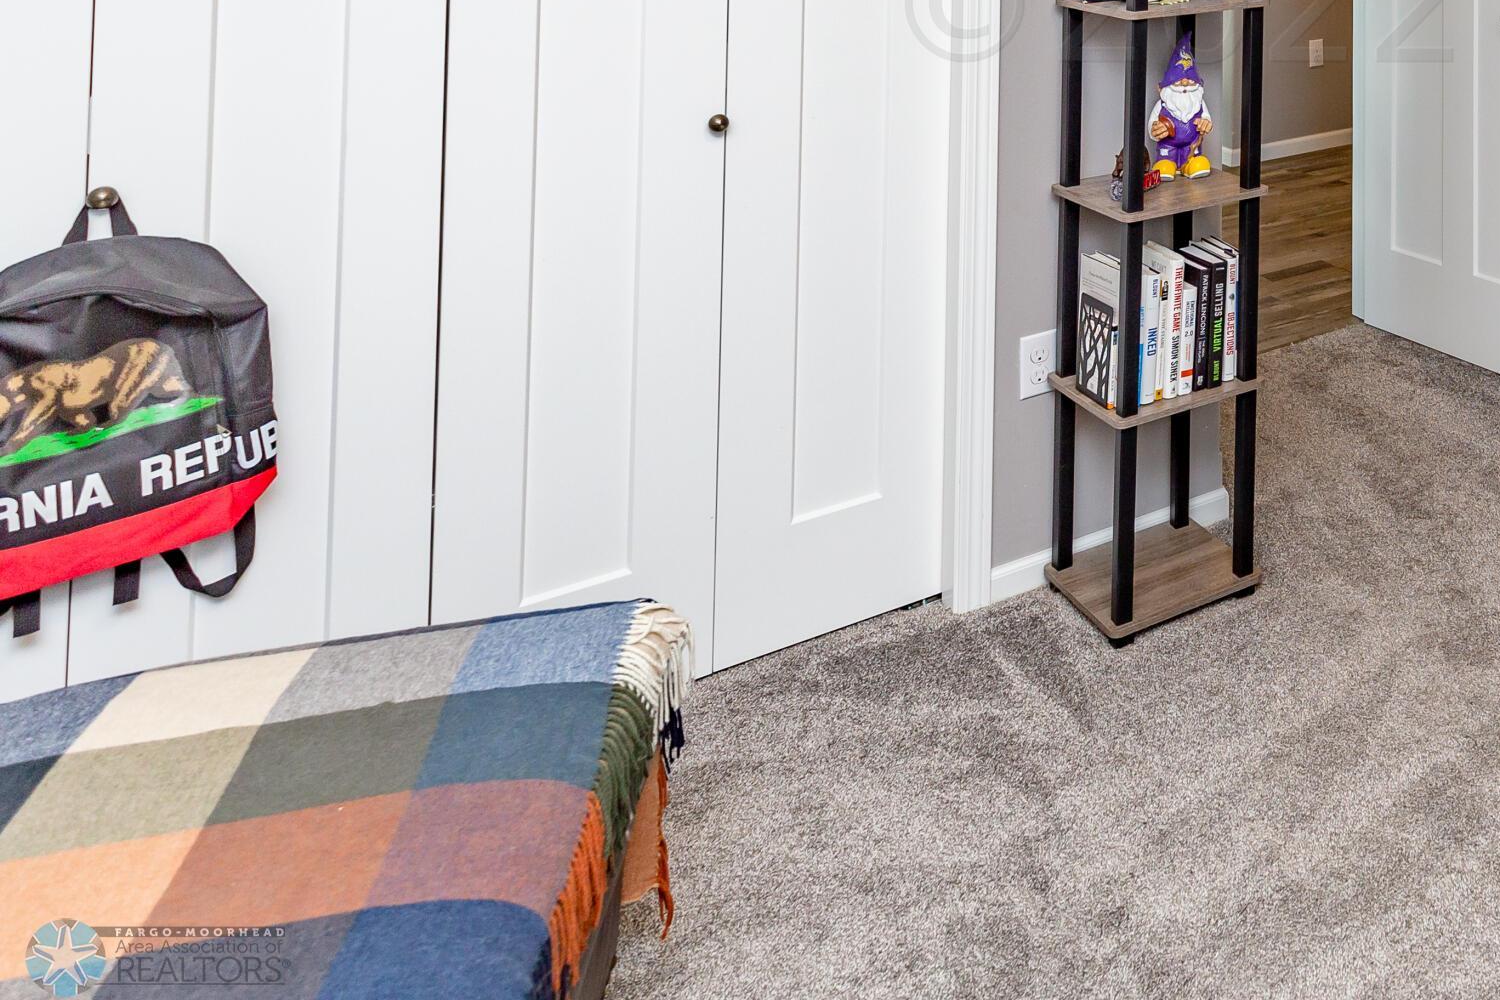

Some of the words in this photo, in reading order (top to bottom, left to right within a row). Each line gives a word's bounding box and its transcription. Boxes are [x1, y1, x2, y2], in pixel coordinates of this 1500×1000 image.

[1175, 266, 1184, 280] THE
[1200, 274, 1209, 302] PATRICK
[1173, 280, 1183, 311] INFINITE
[1214, 283, 1224, 317] SELLING
[1172, 312, 1182, 333] GAME
[1199, 303, 1207, 336] LENCIONI
[1226, 311, 1235, 356] OBJECTIONS
[1147, 327, 1158, 357] INKED
[1171, 335, 1180, 360] SIMON
[1212, 317, 1223, 353] VIRTUAL
[1169, 360, 1178, 383] SINEK
